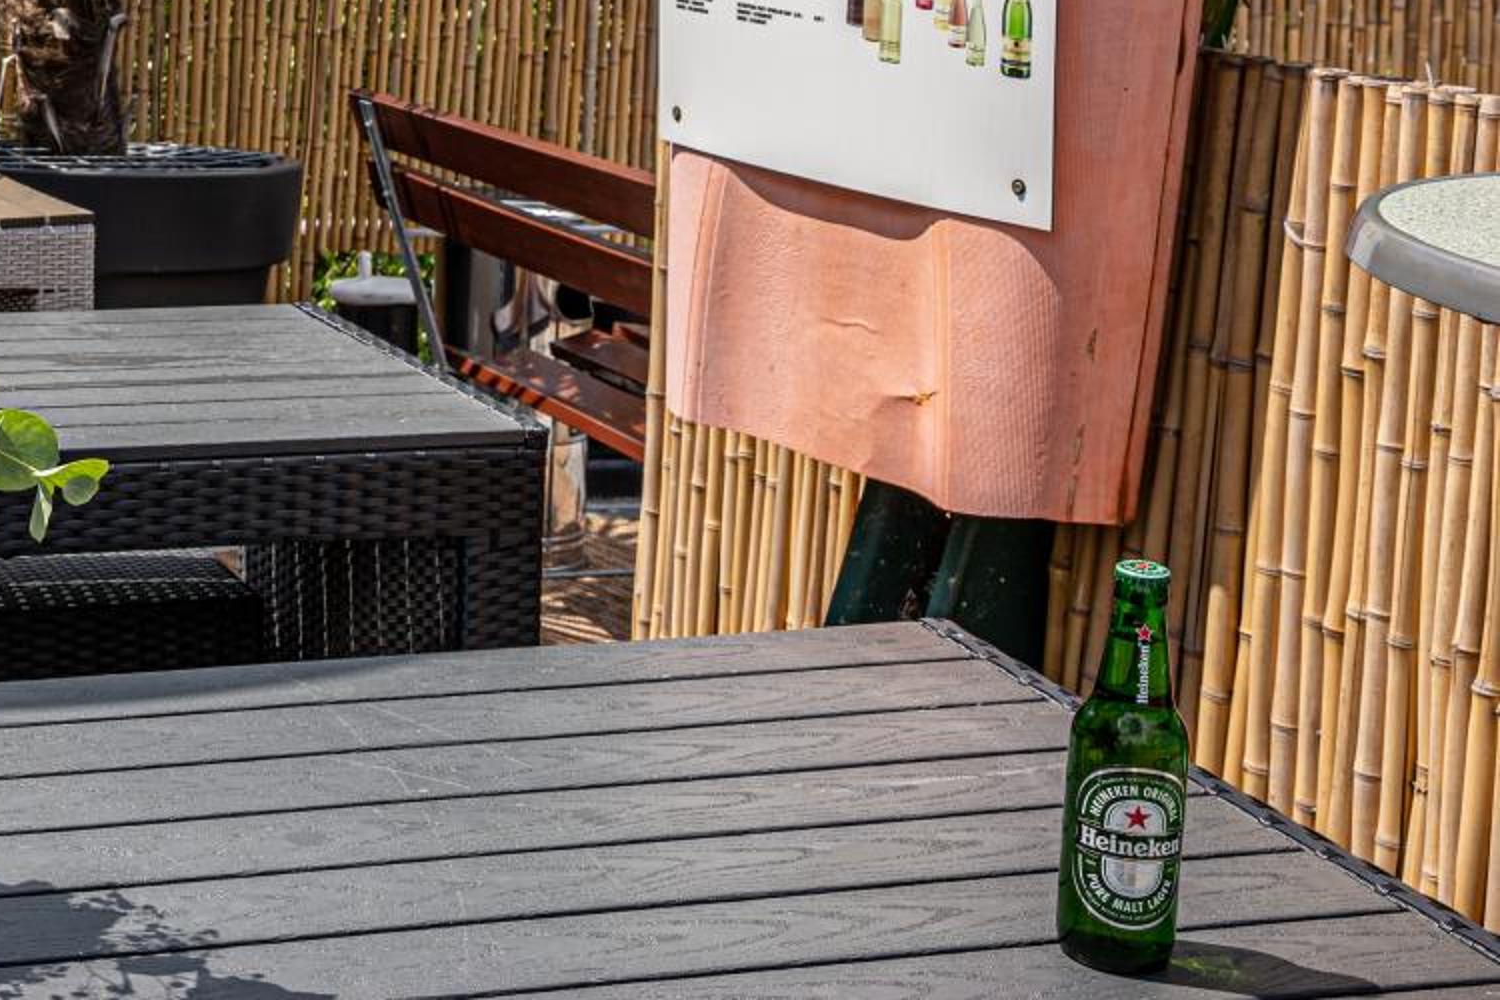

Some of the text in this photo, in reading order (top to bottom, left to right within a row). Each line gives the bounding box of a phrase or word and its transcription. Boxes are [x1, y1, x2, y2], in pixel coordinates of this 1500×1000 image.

[1136, 644, 1150, 704] Heineken
[1089, 785, 1139, 817] HEINEKEN
[1080, 824, 1180, 857] Heineken
[1087, 873, 1172, 913] PURE MALT LAGER
